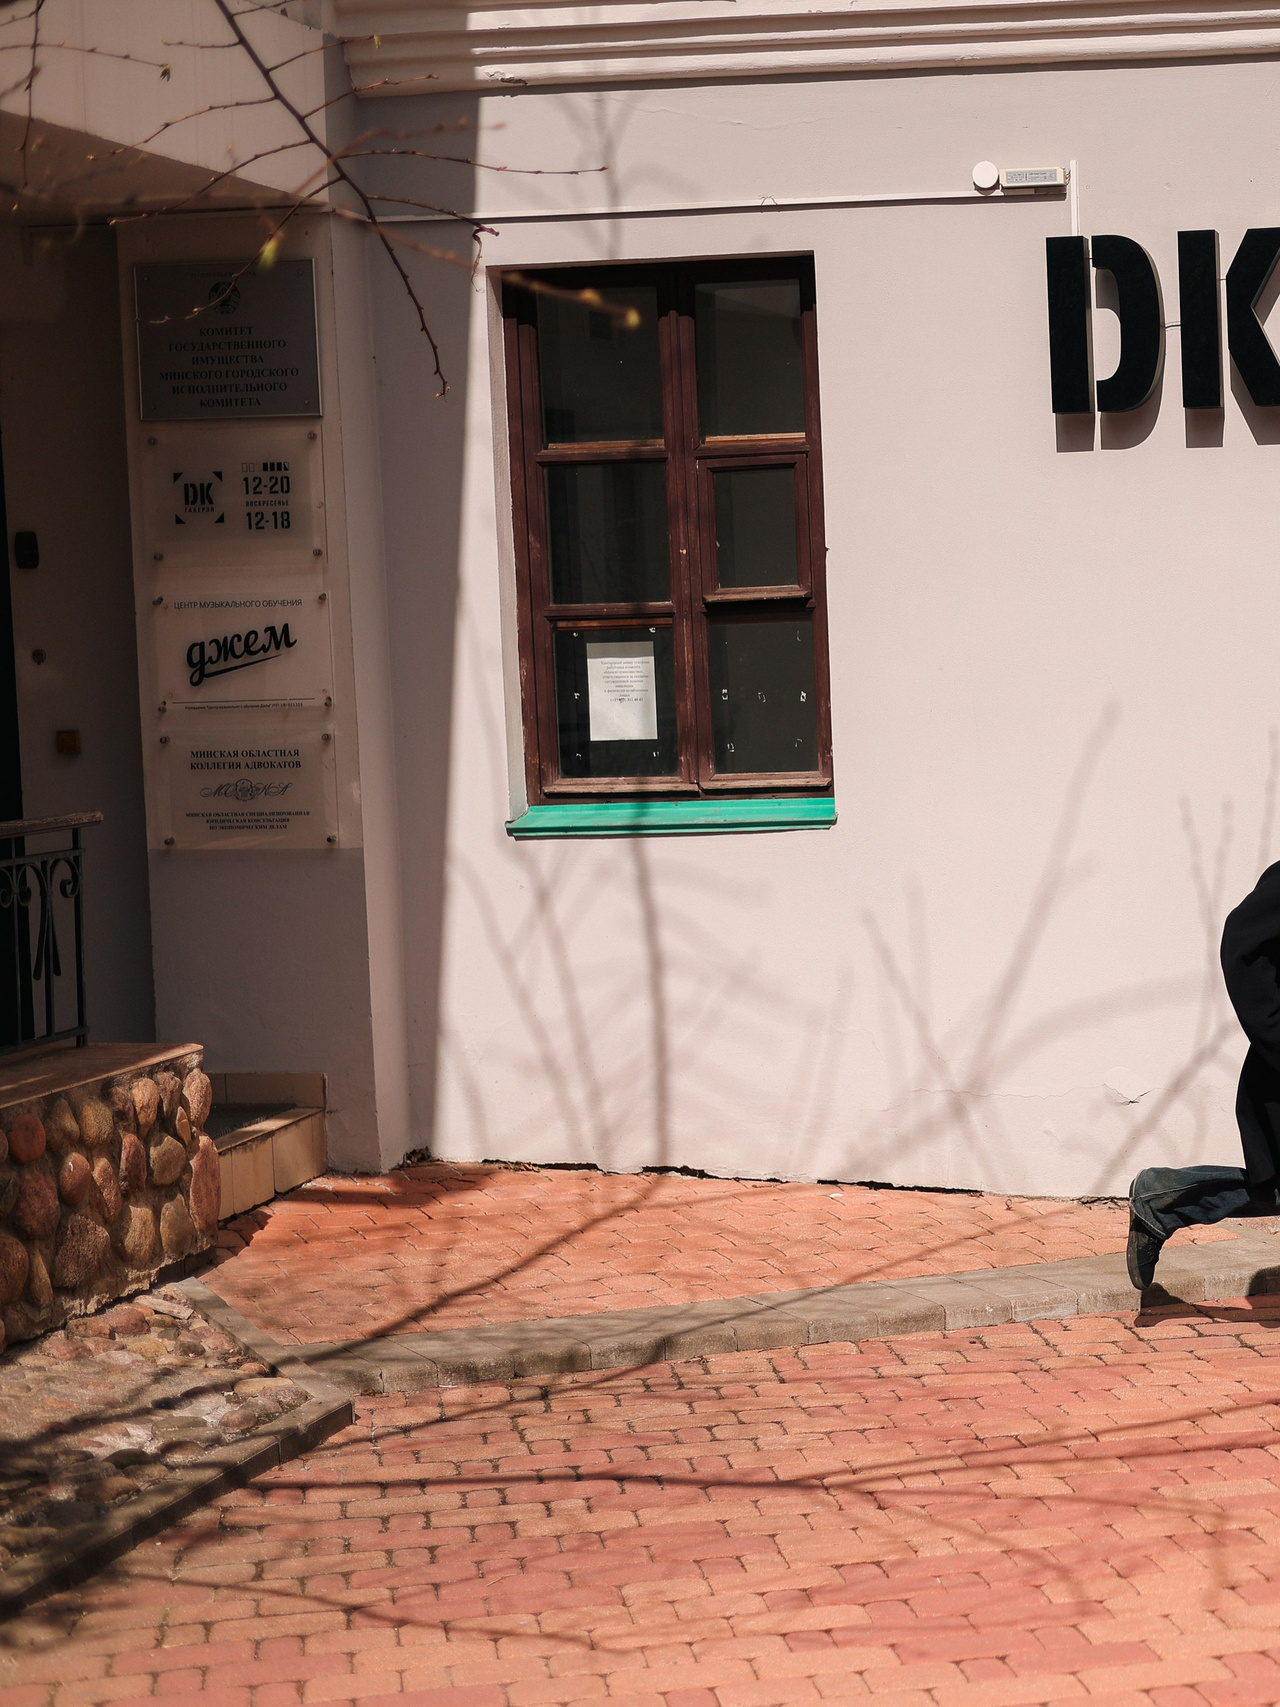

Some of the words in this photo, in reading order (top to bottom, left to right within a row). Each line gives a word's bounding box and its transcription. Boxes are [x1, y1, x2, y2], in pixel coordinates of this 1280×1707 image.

[200, 326, 254, 337] КОМИТЕТ
[168, 339, 287, 352] ГОСУДАРСТВЕННОГО
[191, 354, 264, 366] ИМУЩЕСТВА
[159, 370, 223, 381] МИНСКОГО
[225, 367, 299, 379] ГОРОДСКОГО
[172, 382, 288, 395] ИСПОЛНИТЕЛЬНОГО
[200, 397, 261, 408] КОМИТЕТА
[243, 475, 291, 495] 12-20
[183, 482, 215, 506] DK
[245, 499, 289, 507] ВОСКРЕСЕНЬЕ
[245, 511, 291, 530] 12-18
[174, 602, 199, 610] ЦЕНТР
[199, 600, 261, 609] МУЗЫКАЛЬНОГО
[262, 599, 303, 608] ОБУЧЕНИЯ
[190, 750, 239, 759] МИНСКАЯ
[241, 749, 300, 758] ОБЛАСТНАЯ
[190, 762, 241, 770] КОЛЛЕГИЯ
[243, 761, 301, 770] АДВОКАТОВ
